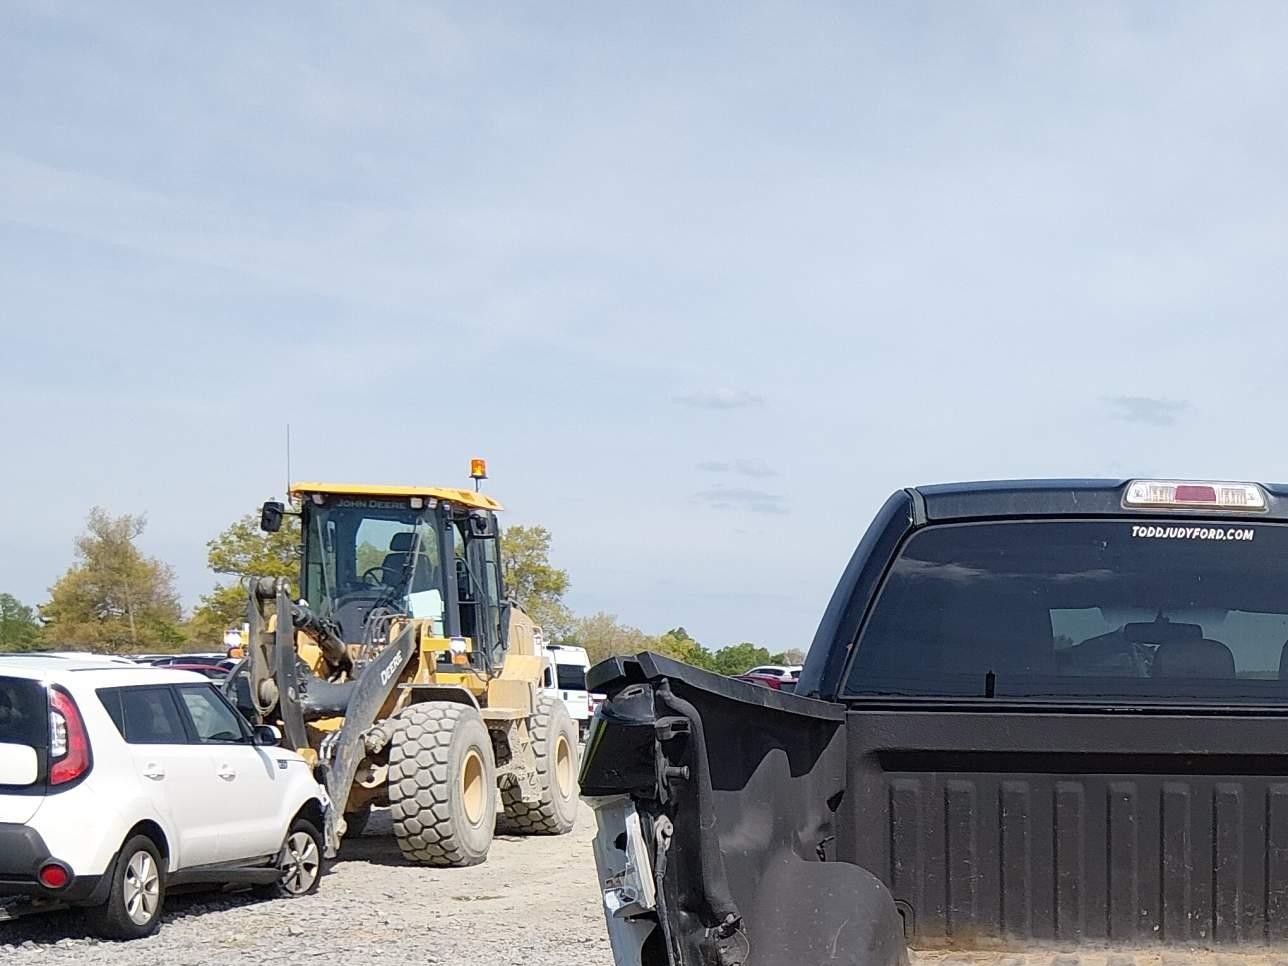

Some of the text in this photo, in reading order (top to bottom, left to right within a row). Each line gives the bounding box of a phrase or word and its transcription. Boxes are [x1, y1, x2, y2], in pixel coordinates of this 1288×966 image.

[336, 499, 407, 509] JOHN DEERE
[1132, 526, 1254, 540] TODDJUDYFORD.COM
[381, 650, 403, 686] DEERE
